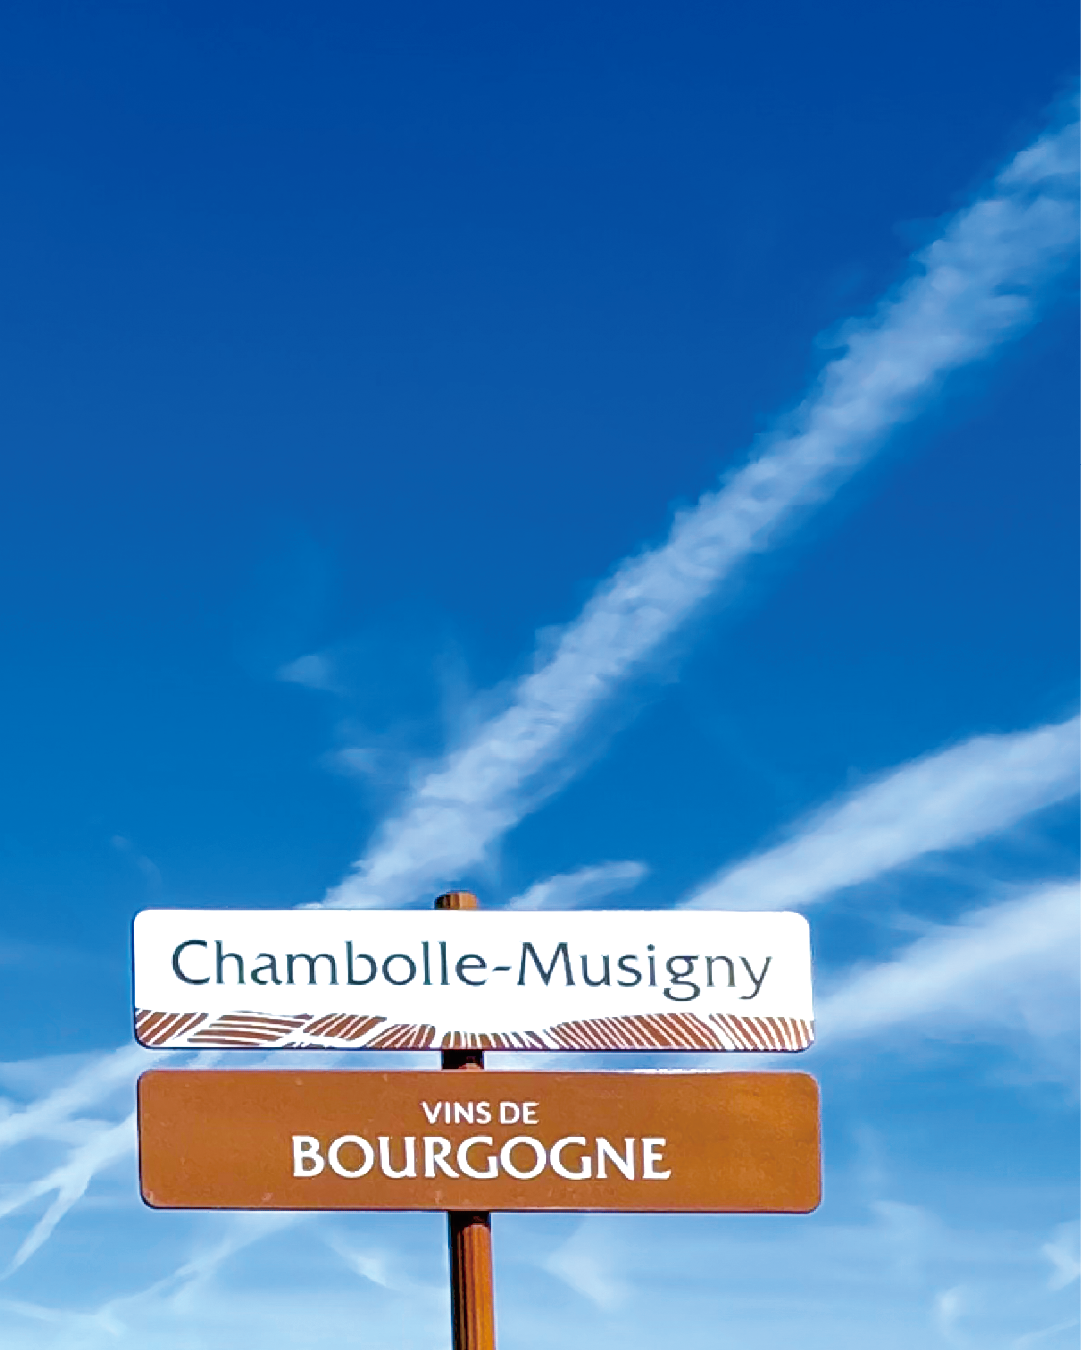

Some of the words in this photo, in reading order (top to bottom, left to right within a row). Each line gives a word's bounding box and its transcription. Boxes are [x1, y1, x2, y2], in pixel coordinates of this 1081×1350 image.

[171, 939, 772, 1001] Chambolle-Musigny
[421, 1101, 492, 1125] VINS
[499, 1101, 539, 1125] DE
[291, 1134, 671, 1181] BOURGOGNE
